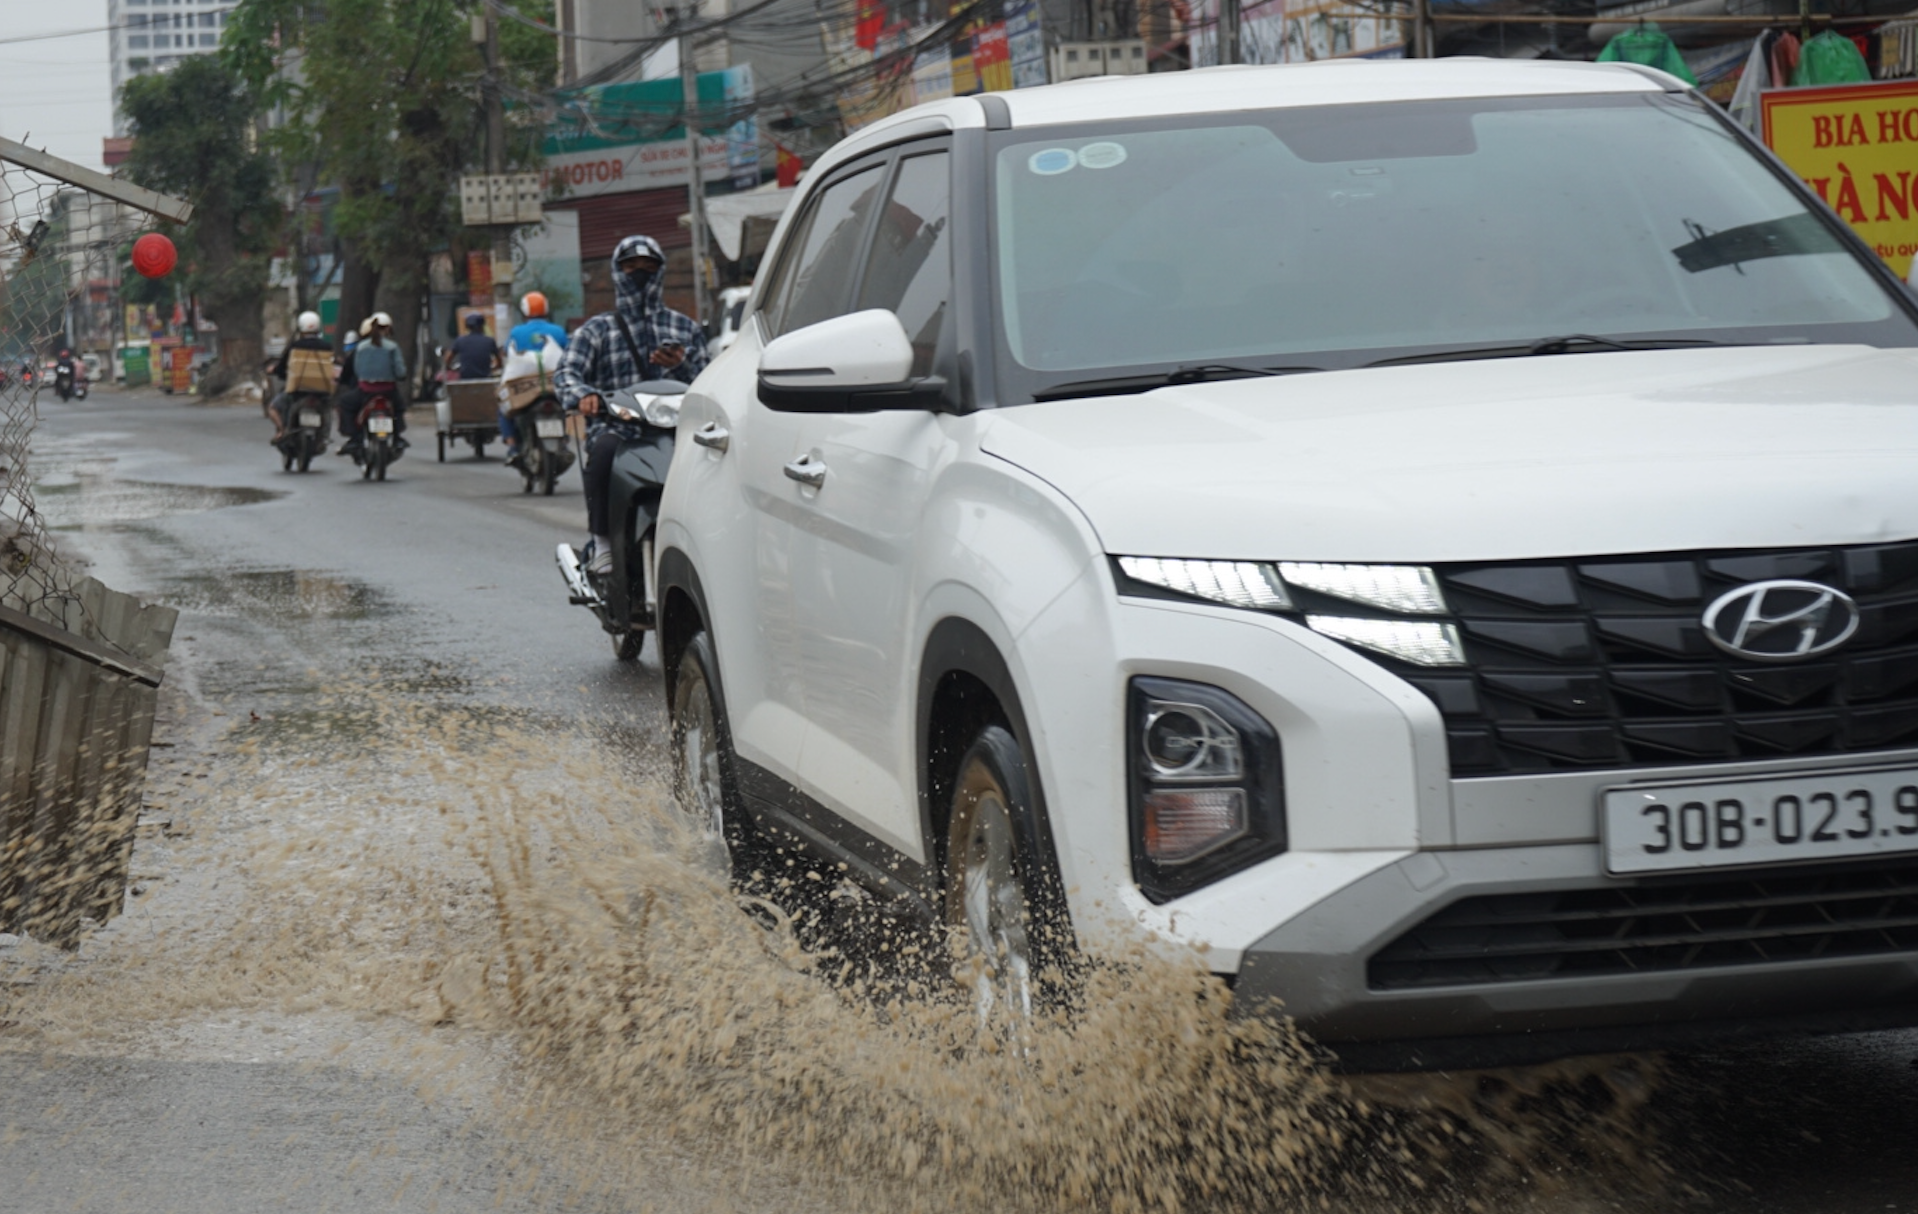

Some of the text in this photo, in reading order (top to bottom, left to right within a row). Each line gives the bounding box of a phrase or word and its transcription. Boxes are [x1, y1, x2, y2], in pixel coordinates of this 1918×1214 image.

[1812, 112, 1869, 148] BIA
[553, 159, 624, 187] MOTOR
[1873, 170, 1918, 222] N
